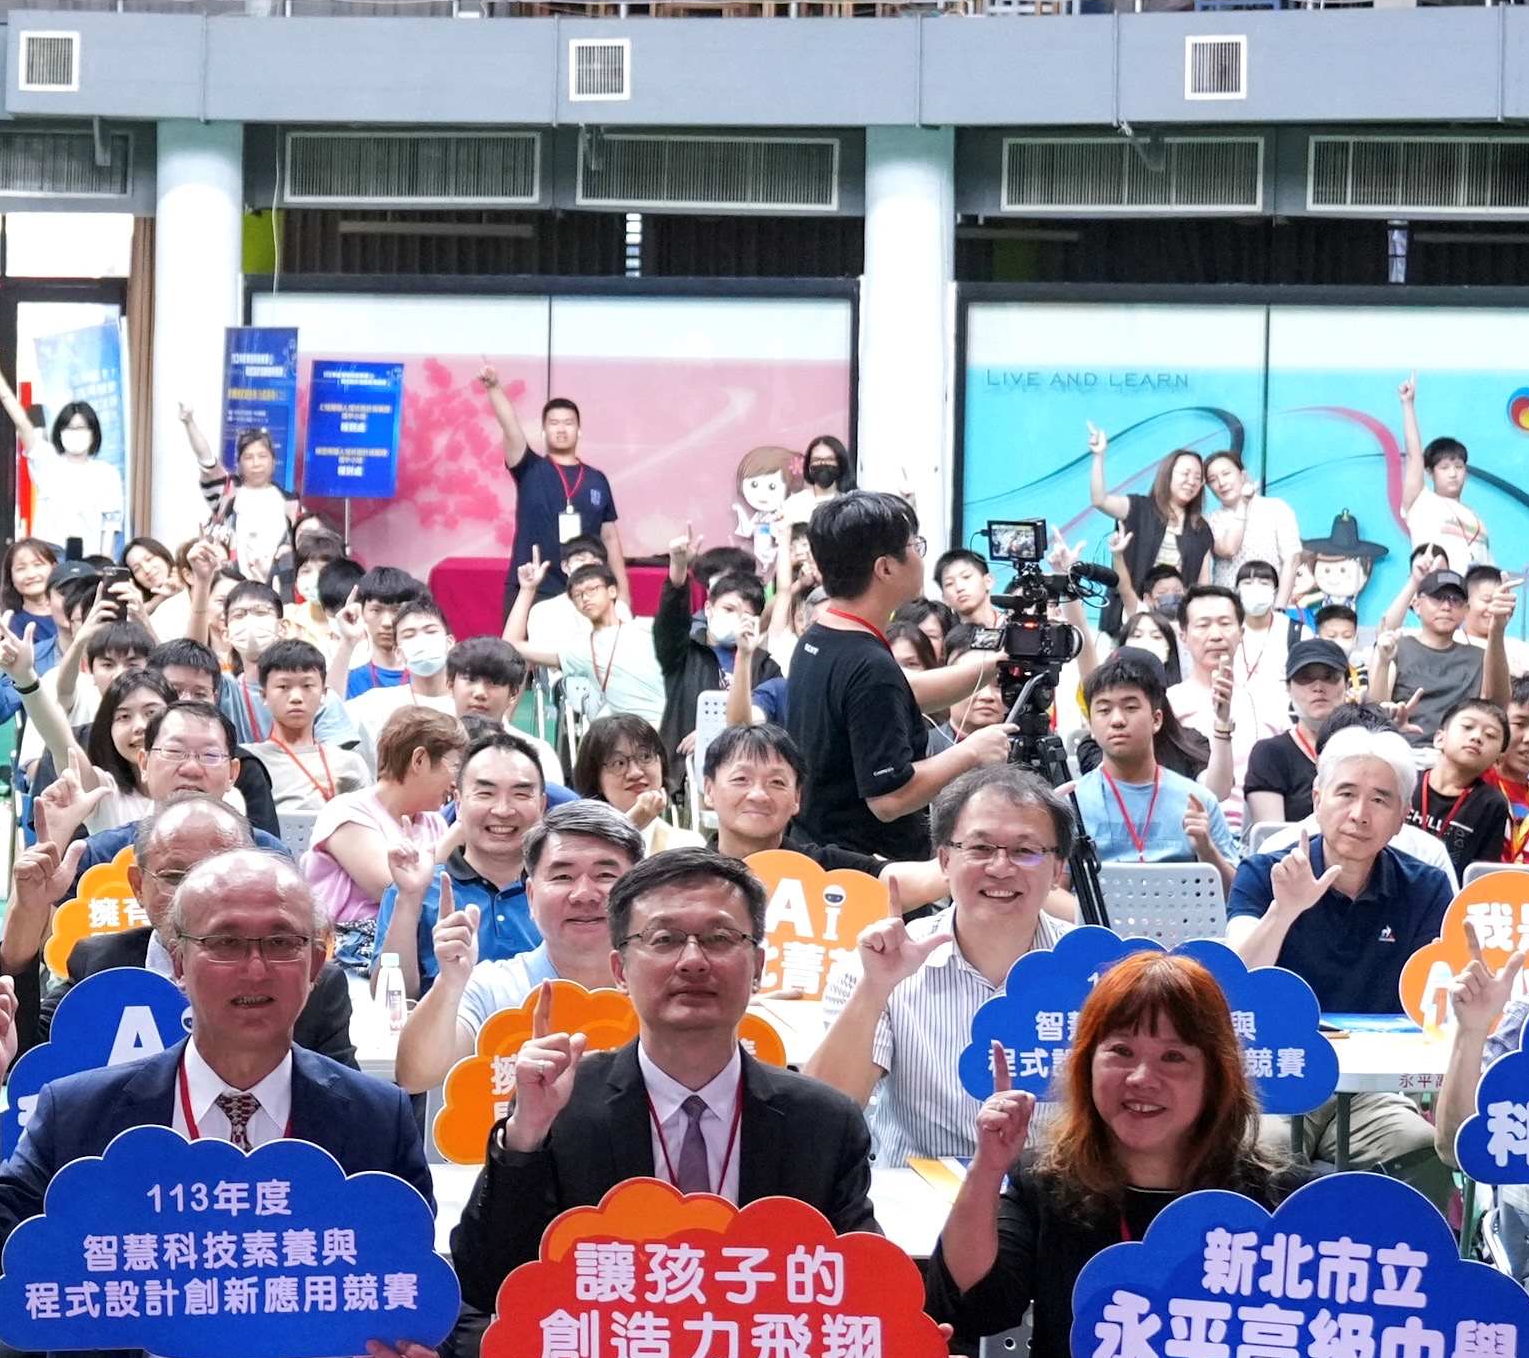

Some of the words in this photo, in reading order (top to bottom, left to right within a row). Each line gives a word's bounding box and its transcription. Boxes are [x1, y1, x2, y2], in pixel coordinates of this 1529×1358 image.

[986, 369, 1040, 387] LIVE
[1050, 372, 1098, 387] AND
[1109, 373, 1189, 387] LEARN
[145, 1179, 293, 1218] 113年度
[83, 1227, 358, 1274] 智慧科技素養與
[1203, 1227, 1428, 1309] 新北市立
[25, 1273, 420, 1322] 程式設計創新應用競賽
[573, 1242, 845, 1308] 讓孩子的
